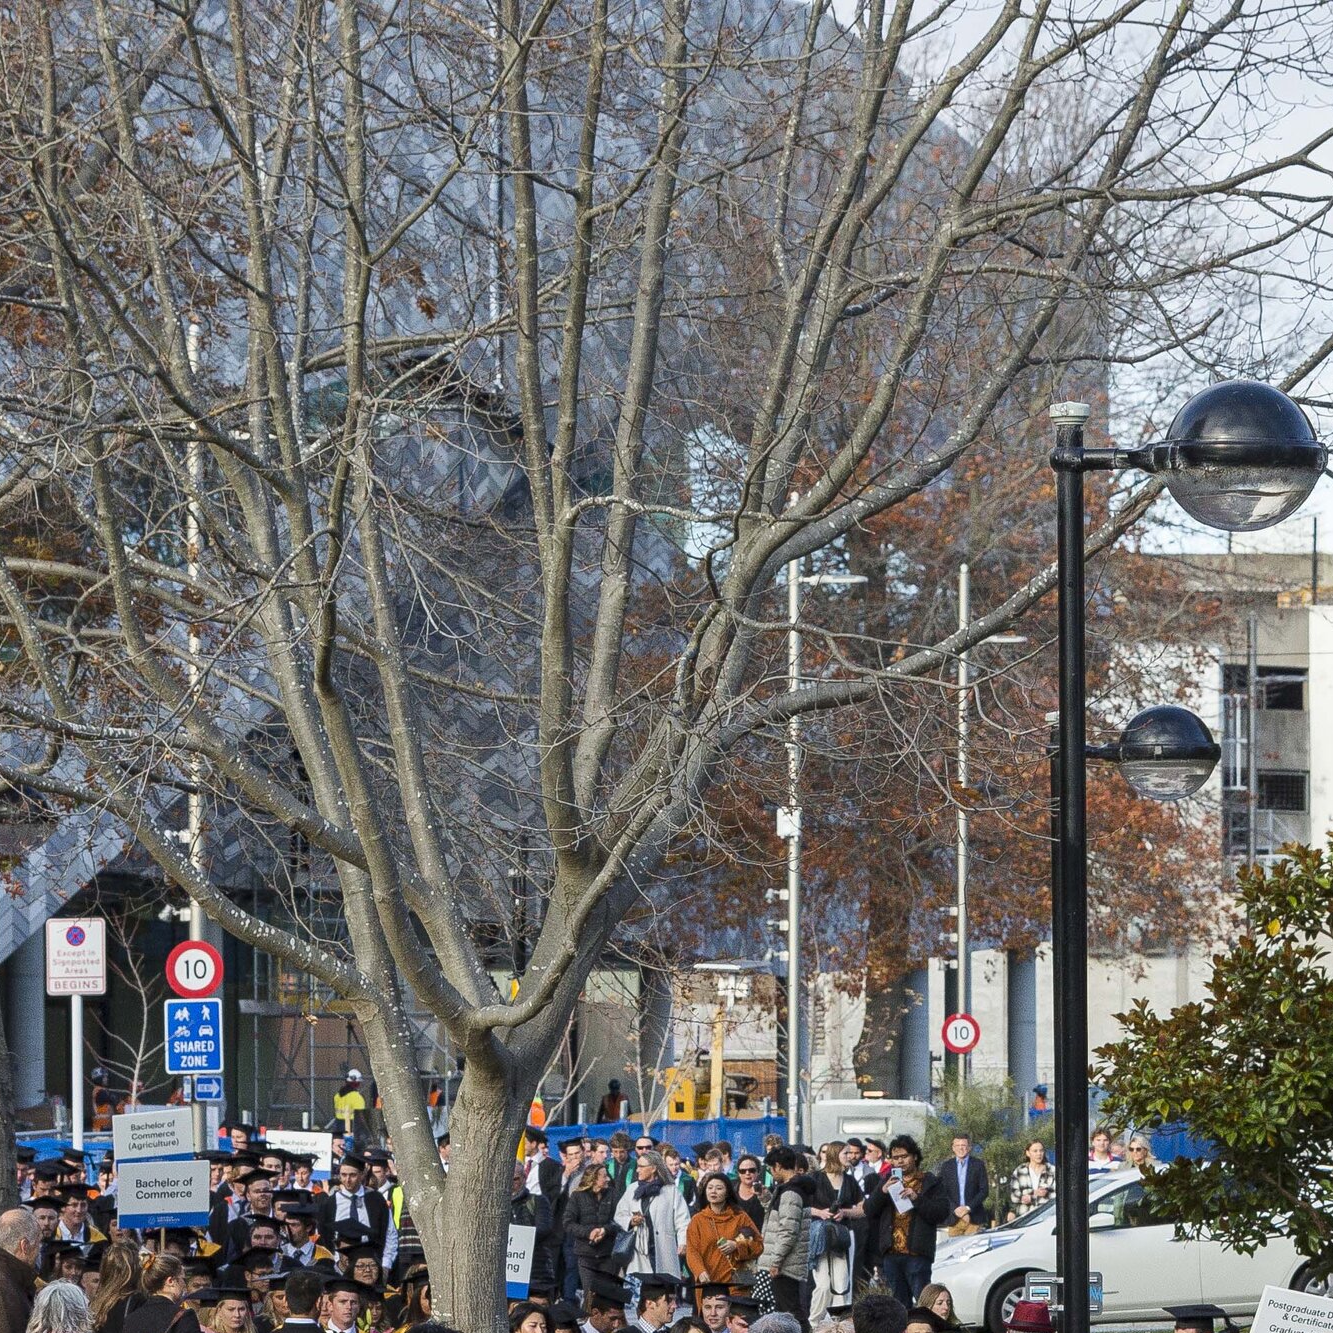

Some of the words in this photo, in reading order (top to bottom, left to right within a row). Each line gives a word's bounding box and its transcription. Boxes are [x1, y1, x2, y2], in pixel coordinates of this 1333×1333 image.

[57, 950, 86, 958] Except
[52, 959, 100, 967] Signposted
[184, 959, 207, 980] 10
[54, 980, 98, 989] BEGINS
[953, 1026, 969, 1040] 10
[173, 1040, 215, 1053] SHARED
[180, 1055, 208, 1068] ZONE
[130, 1121, 165, 1131] Bachelor
[167, 1120, 175, 1128] of
[131, 1131, 175, 1141] Commerce
[128, 1138, 179, 1151] (Agriculture)
[135, 1178, 180, 1188] Bachelor
[182, 1177, 193, 1186] of
[135, 1190, 192, 1200] Commerce
[1267, 1299, 1326, 1318] Postgraduate
